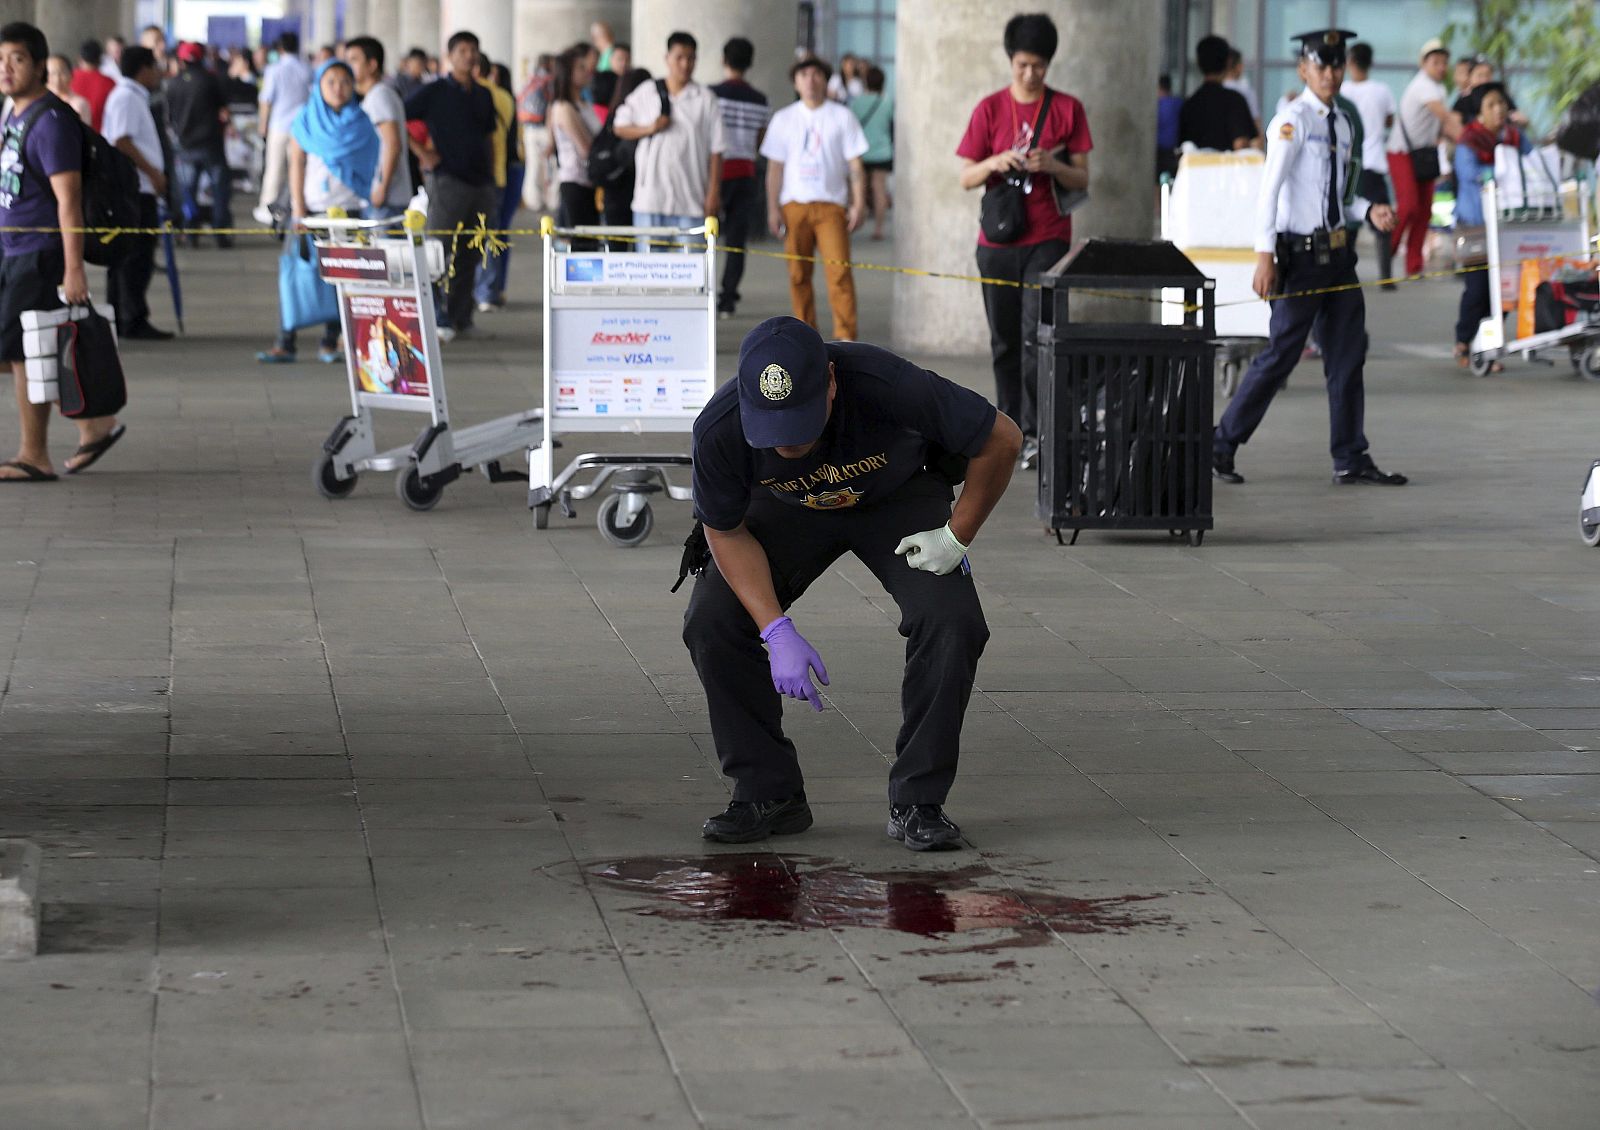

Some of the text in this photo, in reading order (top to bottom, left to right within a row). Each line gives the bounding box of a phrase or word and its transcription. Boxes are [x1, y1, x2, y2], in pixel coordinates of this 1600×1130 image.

[625, 261, 668, 270] Philippine
[608, 271, 692, 280] with your Visa Card
[601, 317, 618, 326] just
[620, 318, 631, 326] go
[643, 318, 658, 326] any
[623, 353, 653, 364] VISA
[798, 452, 889, 490] LABORATORY
